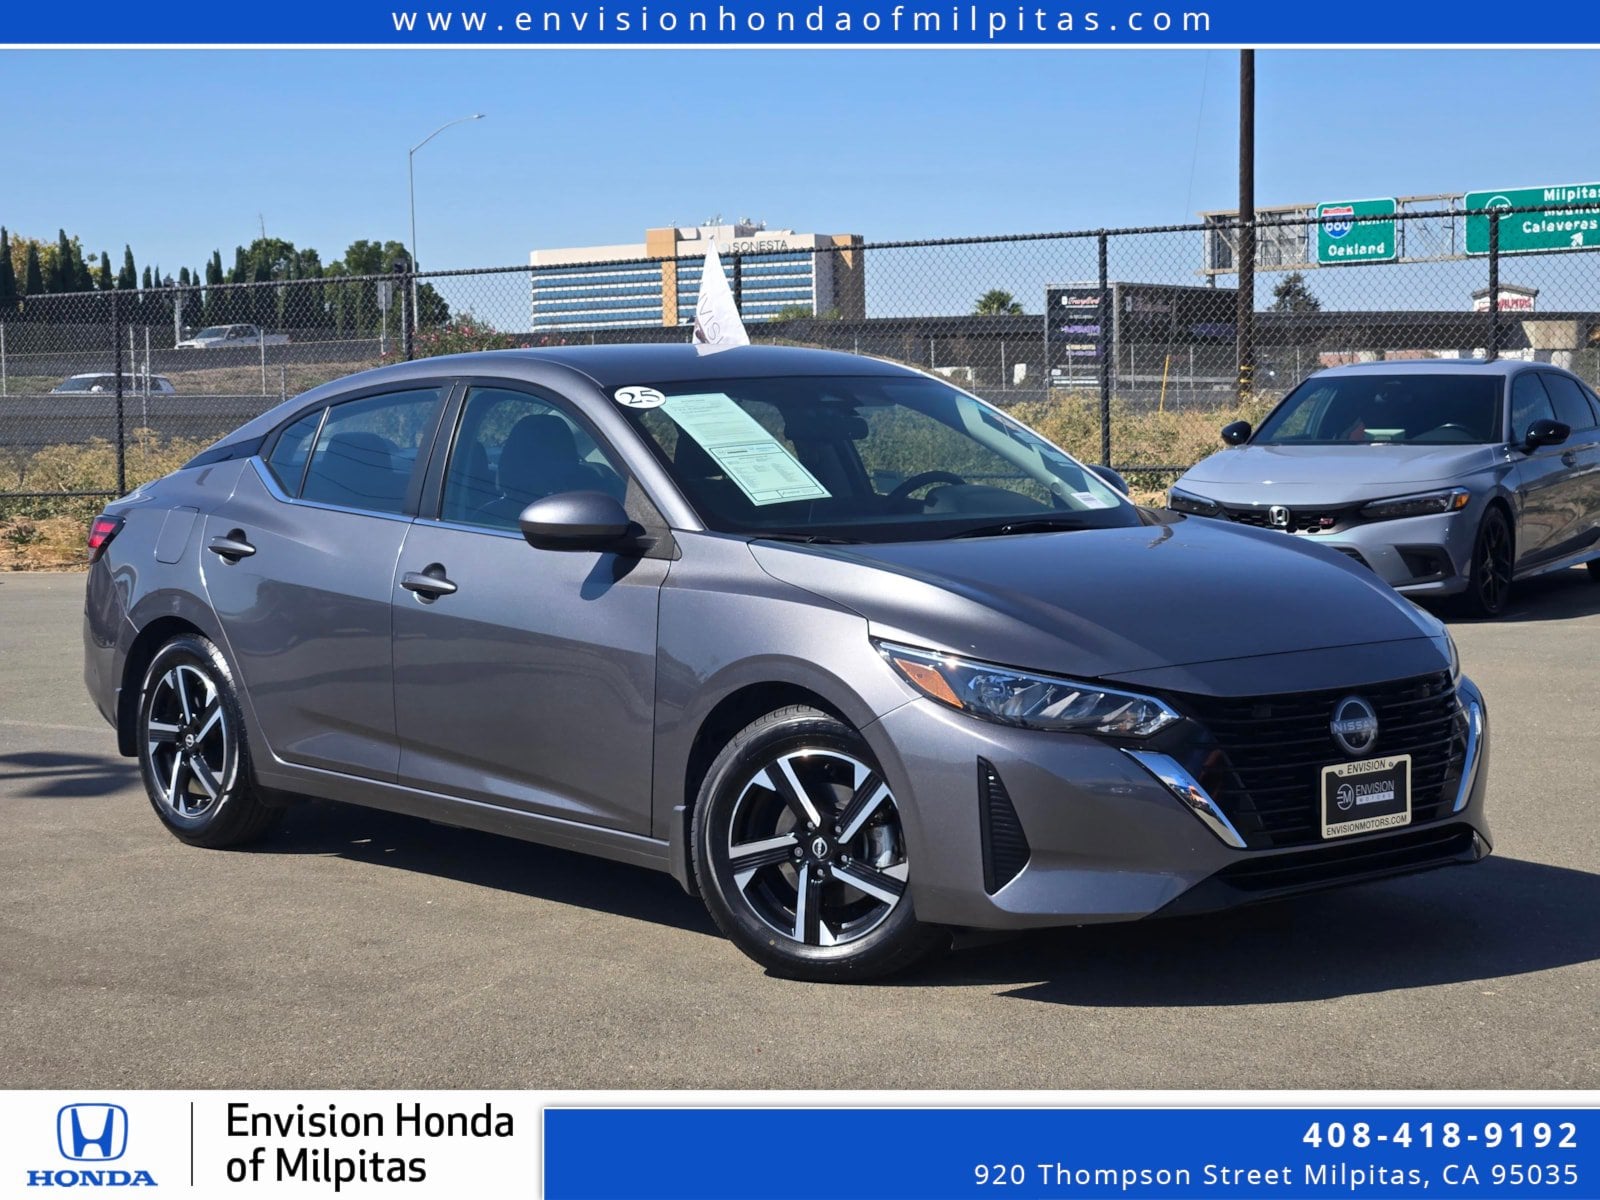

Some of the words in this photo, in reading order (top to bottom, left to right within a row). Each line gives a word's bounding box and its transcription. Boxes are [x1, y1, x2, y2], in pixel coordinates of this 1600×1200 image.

[1543, 187, 1600, 202] Milpita
[1522, 219, 1598, 233] Calaveras
[733, 240, 788, 252] SONESTA
[1328, 242, 1385, 256] Oakland
[619, 389, 661, 405] 25
[1334, 720, 1376, 732] NISSAN
[1347, 759, 1386, 774] ENVISION
[1355, 780, 1395, 796] ENVISION
[1326, 815, 1407, 836] ENVISIONMOTORS.COM
